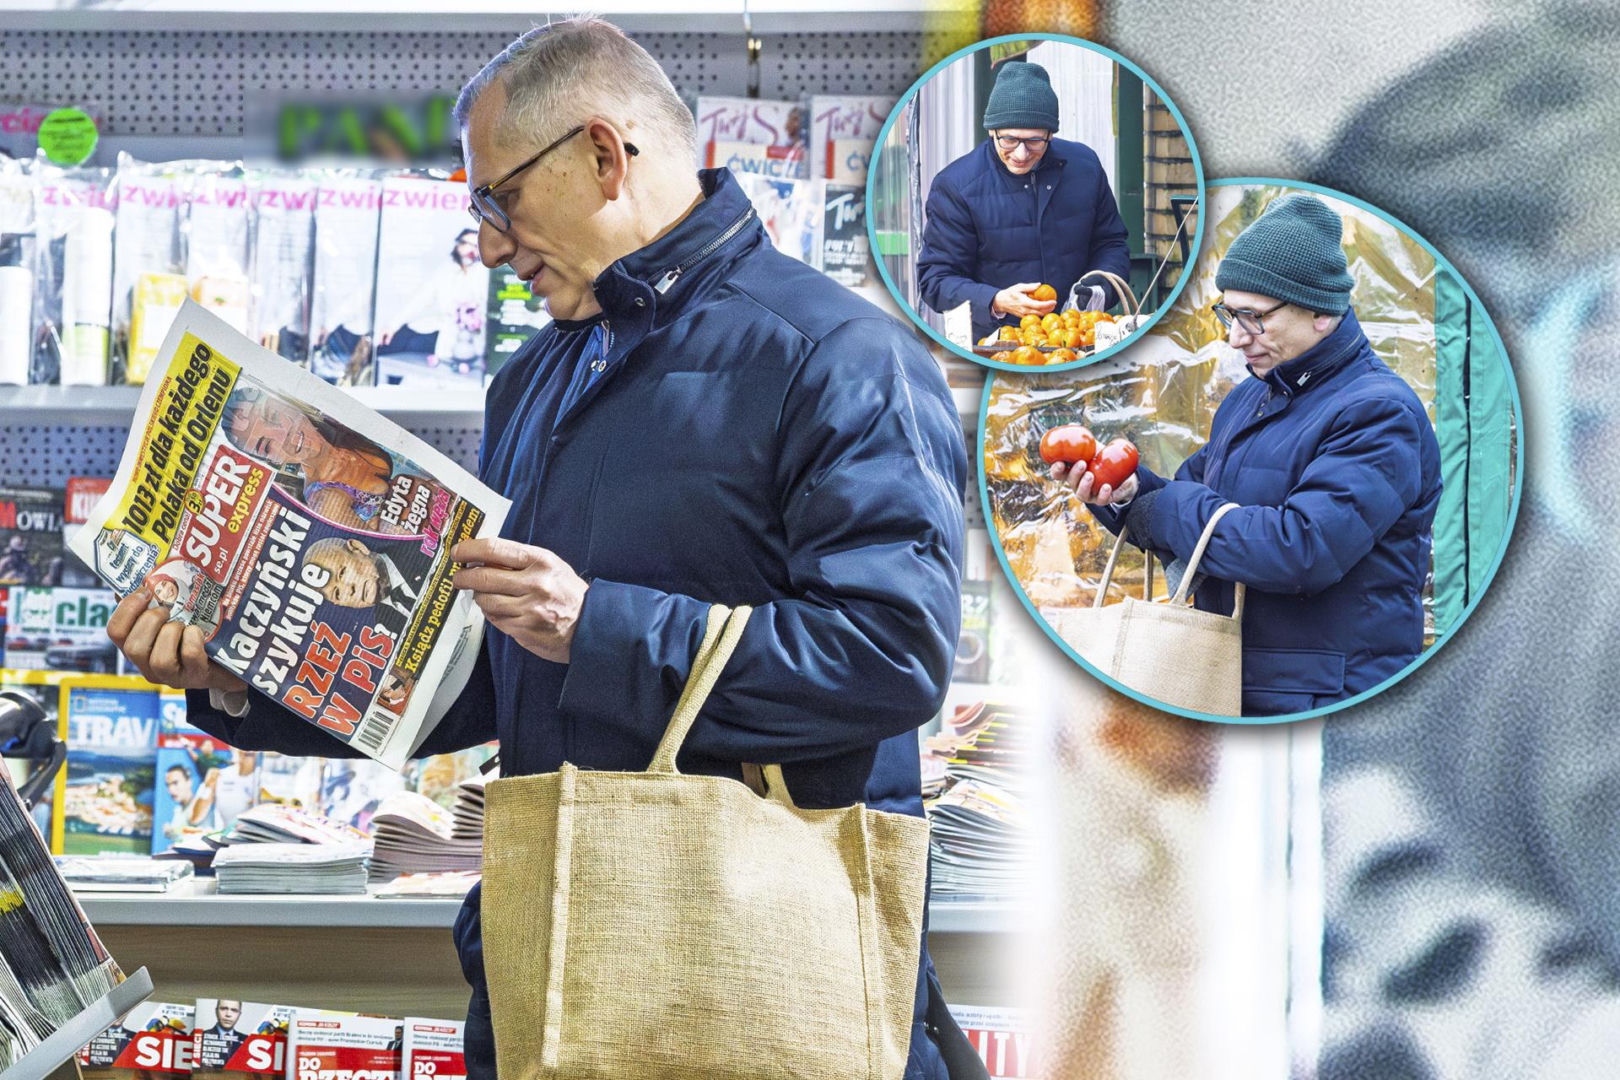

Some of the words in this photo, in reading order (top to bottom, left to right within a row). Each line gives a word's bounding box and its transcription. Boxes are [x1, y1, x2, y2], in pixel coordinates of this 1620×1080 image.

[158, 343, 211, 436] każdego
[187, 368, 231, 442] Orlenu
[149, 432, 173, 470] dla
[180, 435, 201, 471] od
[144, 462, 163, 493] zł
[227, 467, 264, 534] express
[380, 475, 413, 525] Edyta
[122, 485, 156, 535] 1013
[152, 469, 190, 543] Polaka
[186, 455, 251, 567] SUPER
[400, 484, 431, 535] żegna
[132, 545, 144, 557] do
[214, 547, 229, 575] se.pl
[420, 524, 440, 558] rok
[200, 584, 223, 622] Niemcom
[214, 507, 311, 674] Kaczyński
[252, 563, 330, 696] szykuje
[404, 624, 434, 674] Ksiądz
[428, 578, 455, 628] pedofil
[282, 620, 352, 719] RZEŹ
[135, 1036, 192, 1069] SIE
[299, 1057, 321, 1070] DO
[414, 1061, 437, 1075] DO
